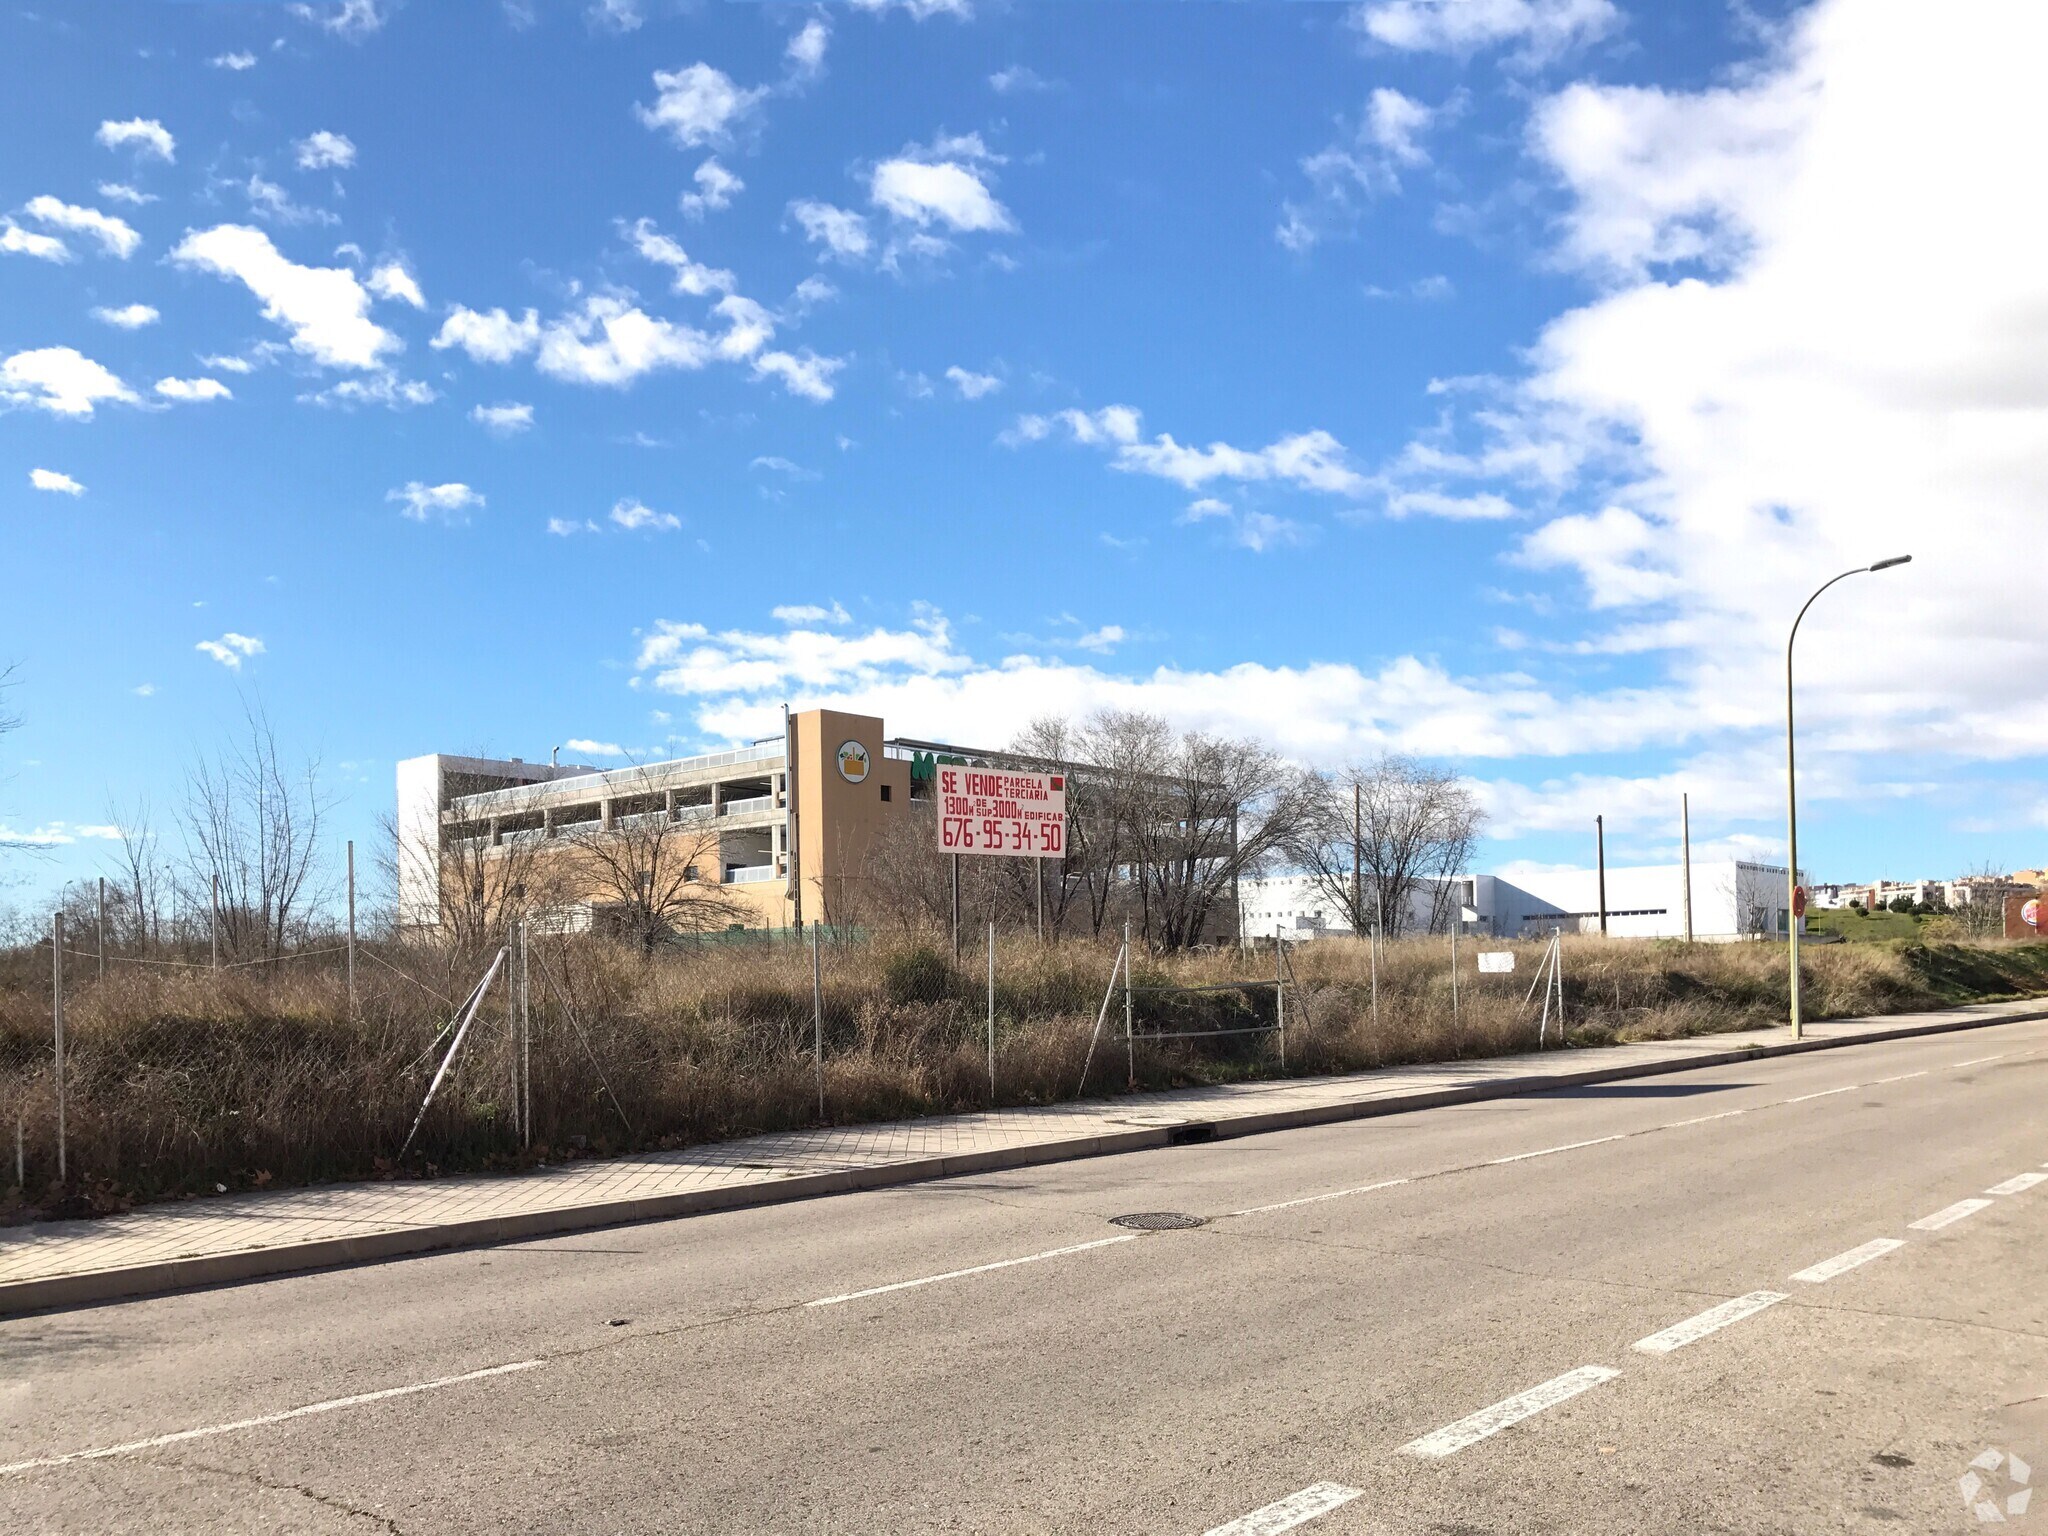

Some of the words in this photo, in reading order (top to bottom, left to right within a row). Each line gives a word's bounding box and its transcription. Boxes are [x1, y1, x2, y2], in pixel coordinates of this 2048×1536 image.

[942, 771, 957, 794] SE
[965, 773, 1003, 797] VENDE
[1004, 777, 1043, 789] PARCELA
[1005, 788, 1049, 801] TERCIARIA
[977, 798, 987, 807] DE
